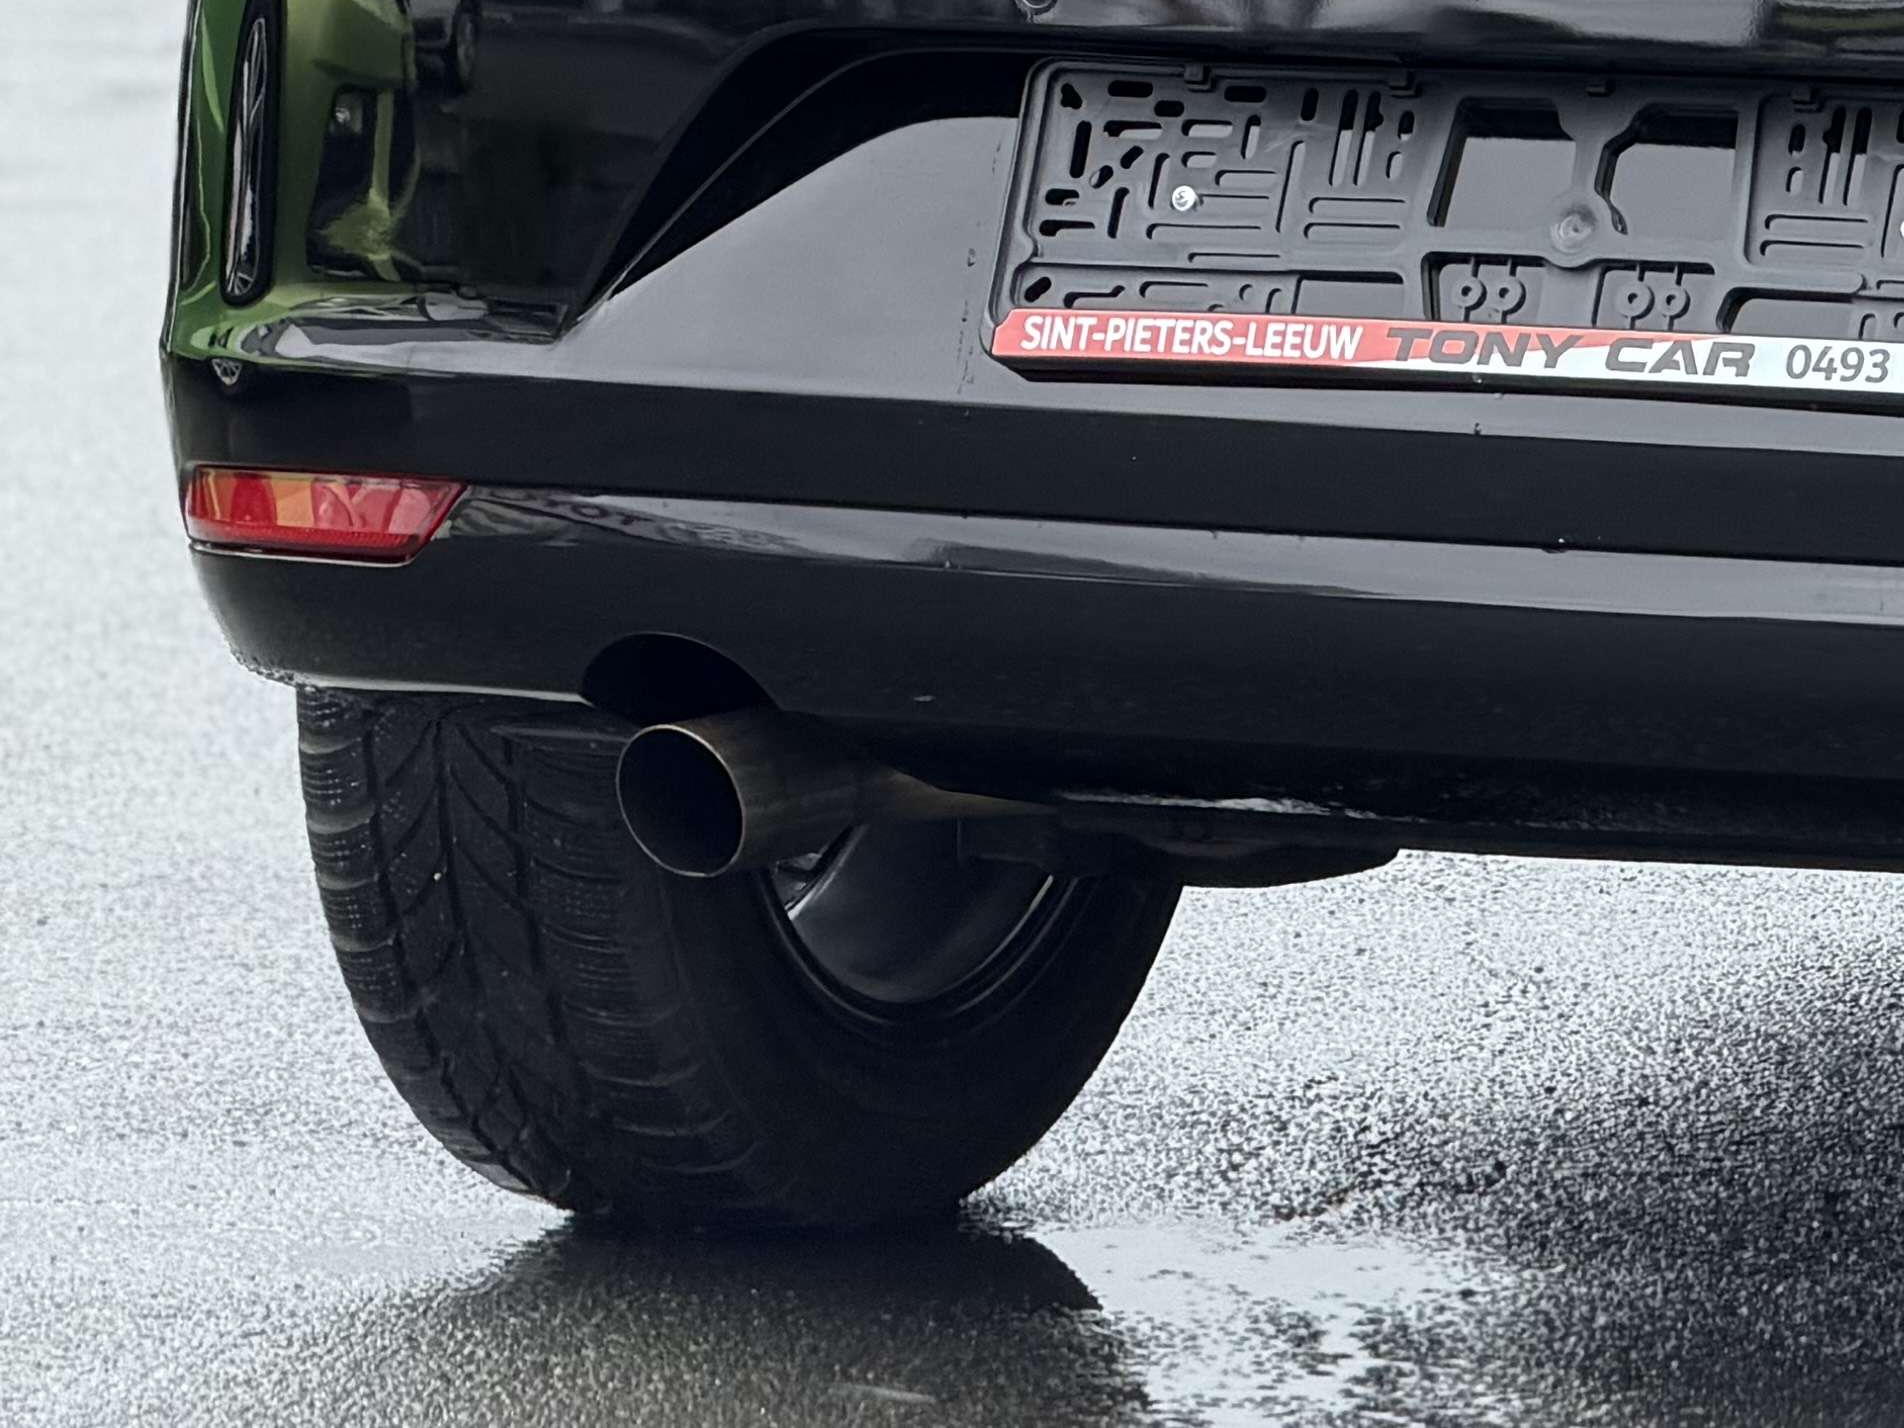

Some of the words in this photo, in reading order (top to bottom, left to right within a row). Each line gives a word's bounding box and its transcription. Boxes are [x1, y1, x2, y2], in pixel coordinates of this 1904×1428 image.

[1020, 315, 1365, 361] SINT-PIETERS-LEEUW
[1386, 326, 1582, 370] TONY
[1604, 337, 1756, 378] CAR
[1785, 344, 1891, 384] 0493
